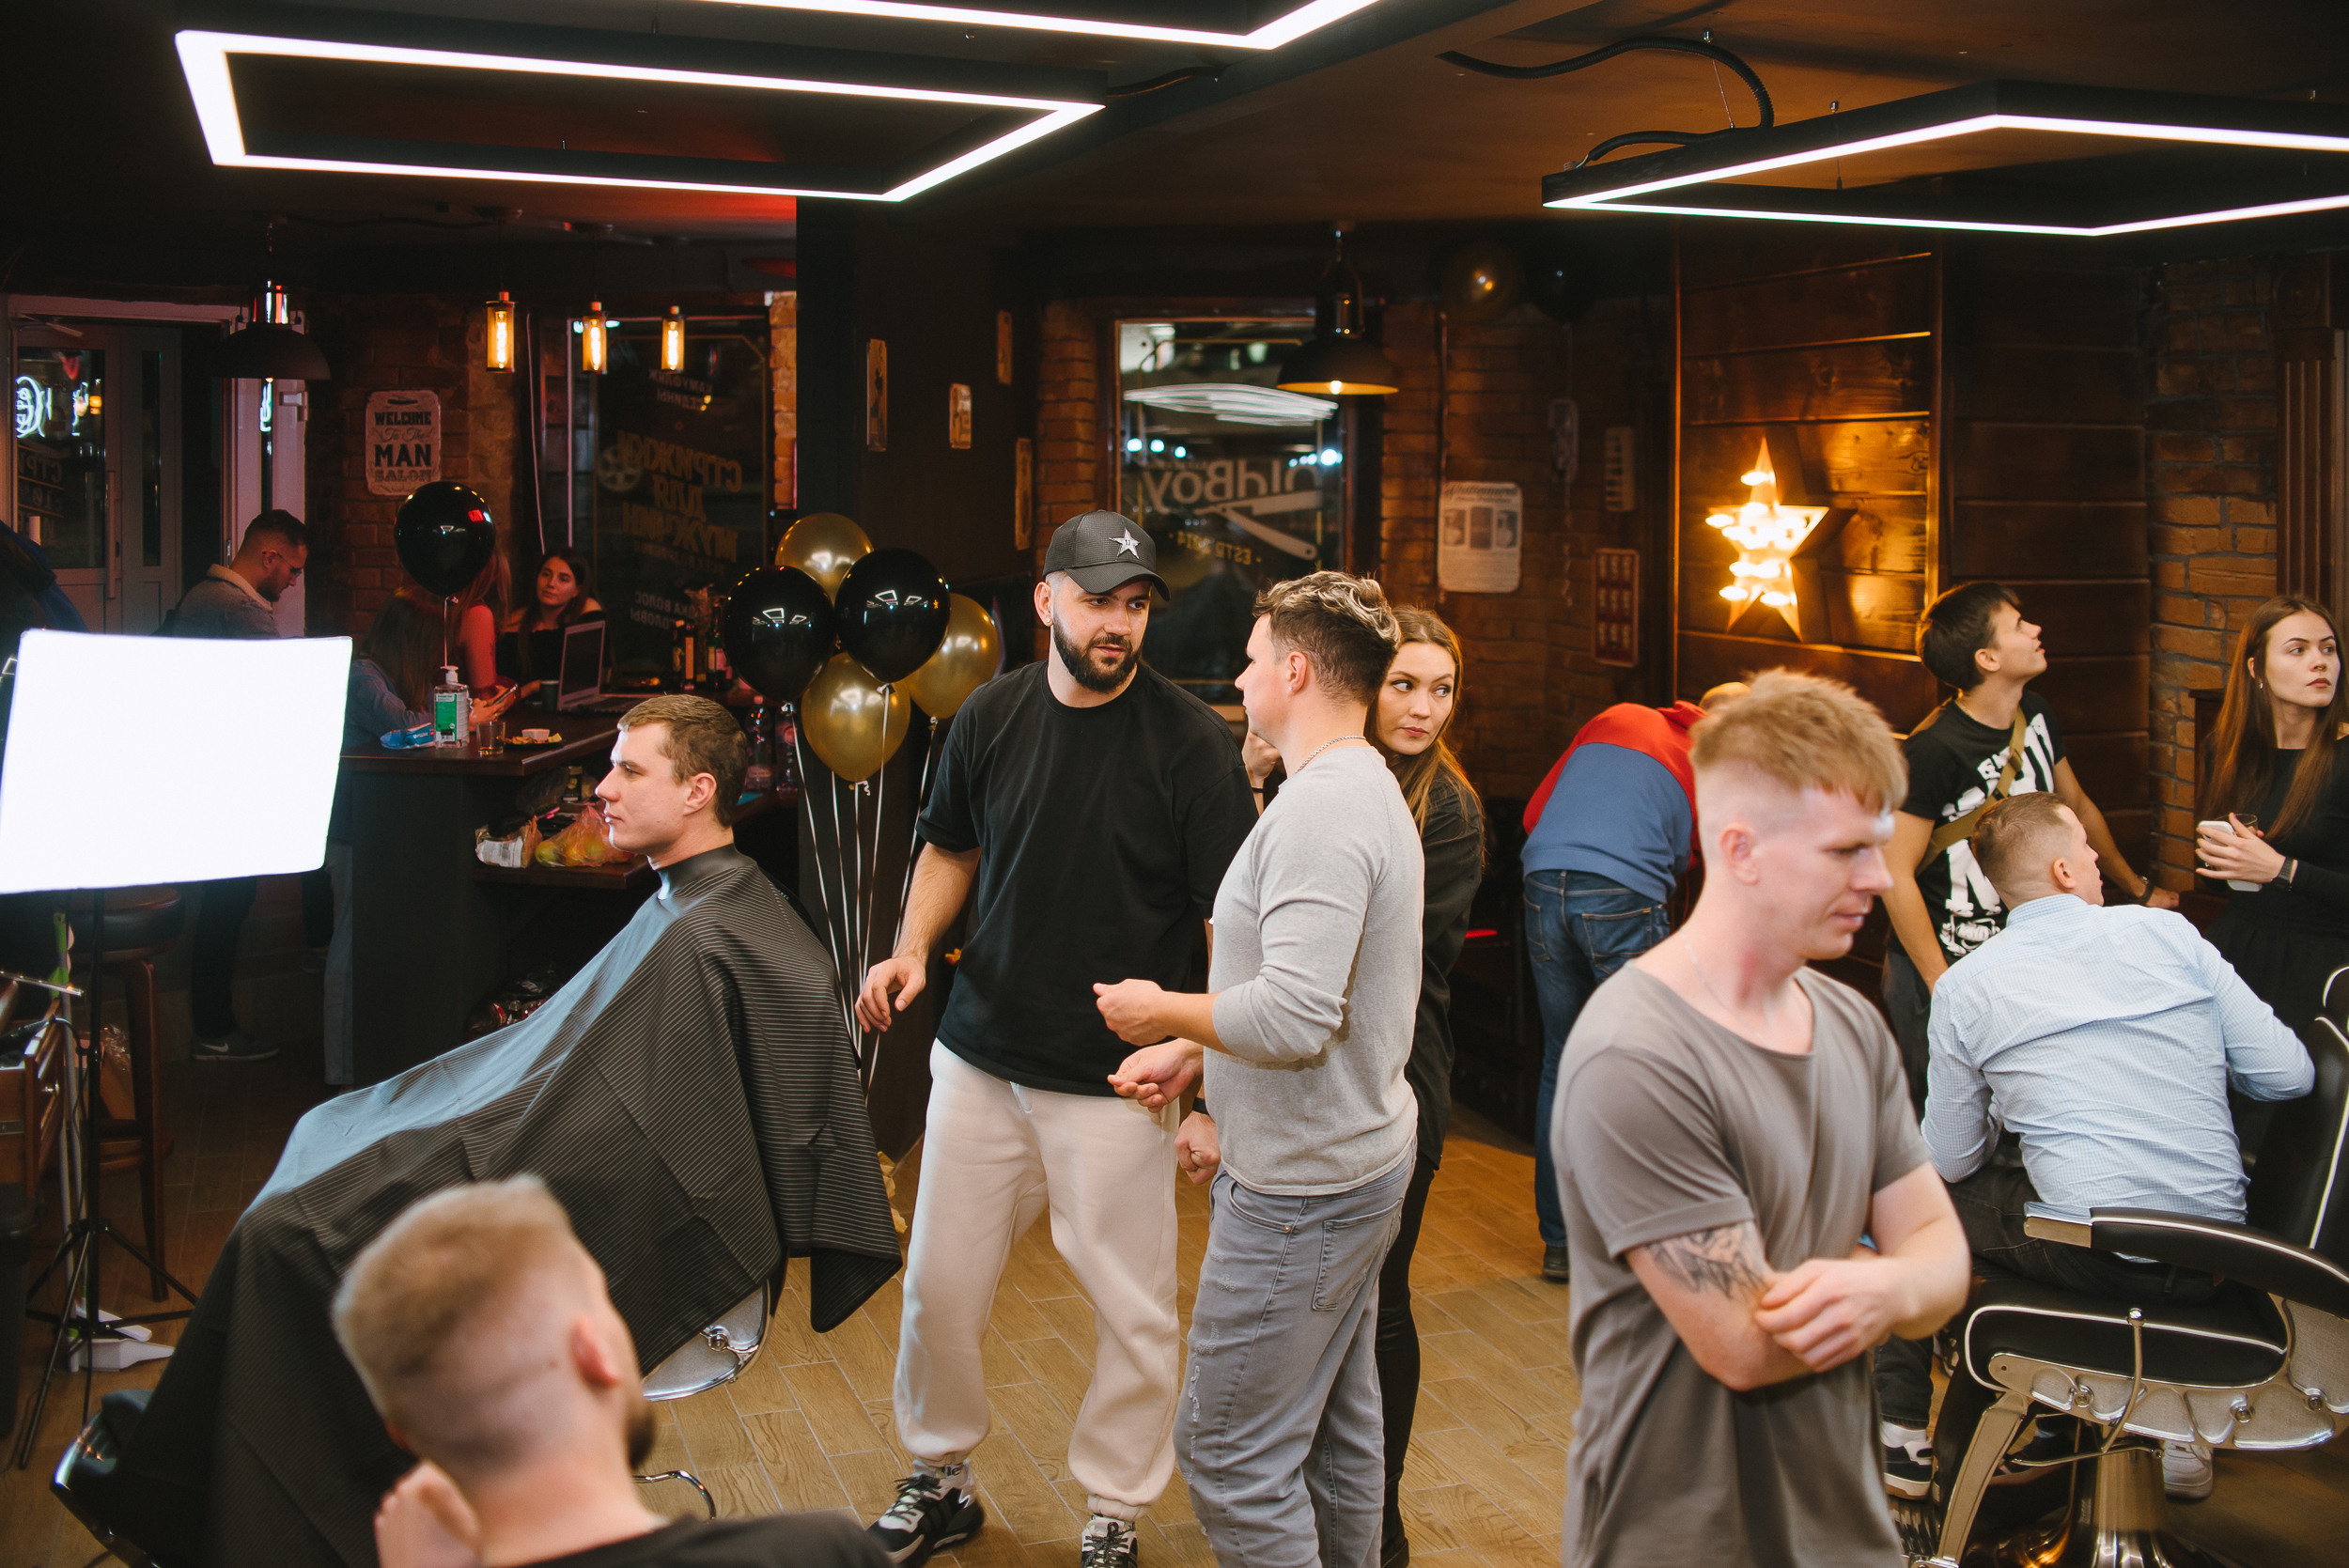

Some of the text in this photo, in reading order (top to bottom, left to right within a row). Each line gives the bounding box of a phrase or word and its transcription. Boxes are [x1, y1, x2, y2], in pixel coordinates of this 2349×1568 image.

[374, 411, 431, 426] WELCOME
[374, 443, 431, 467] MAN
[374, 470, 431, 482] SALON
